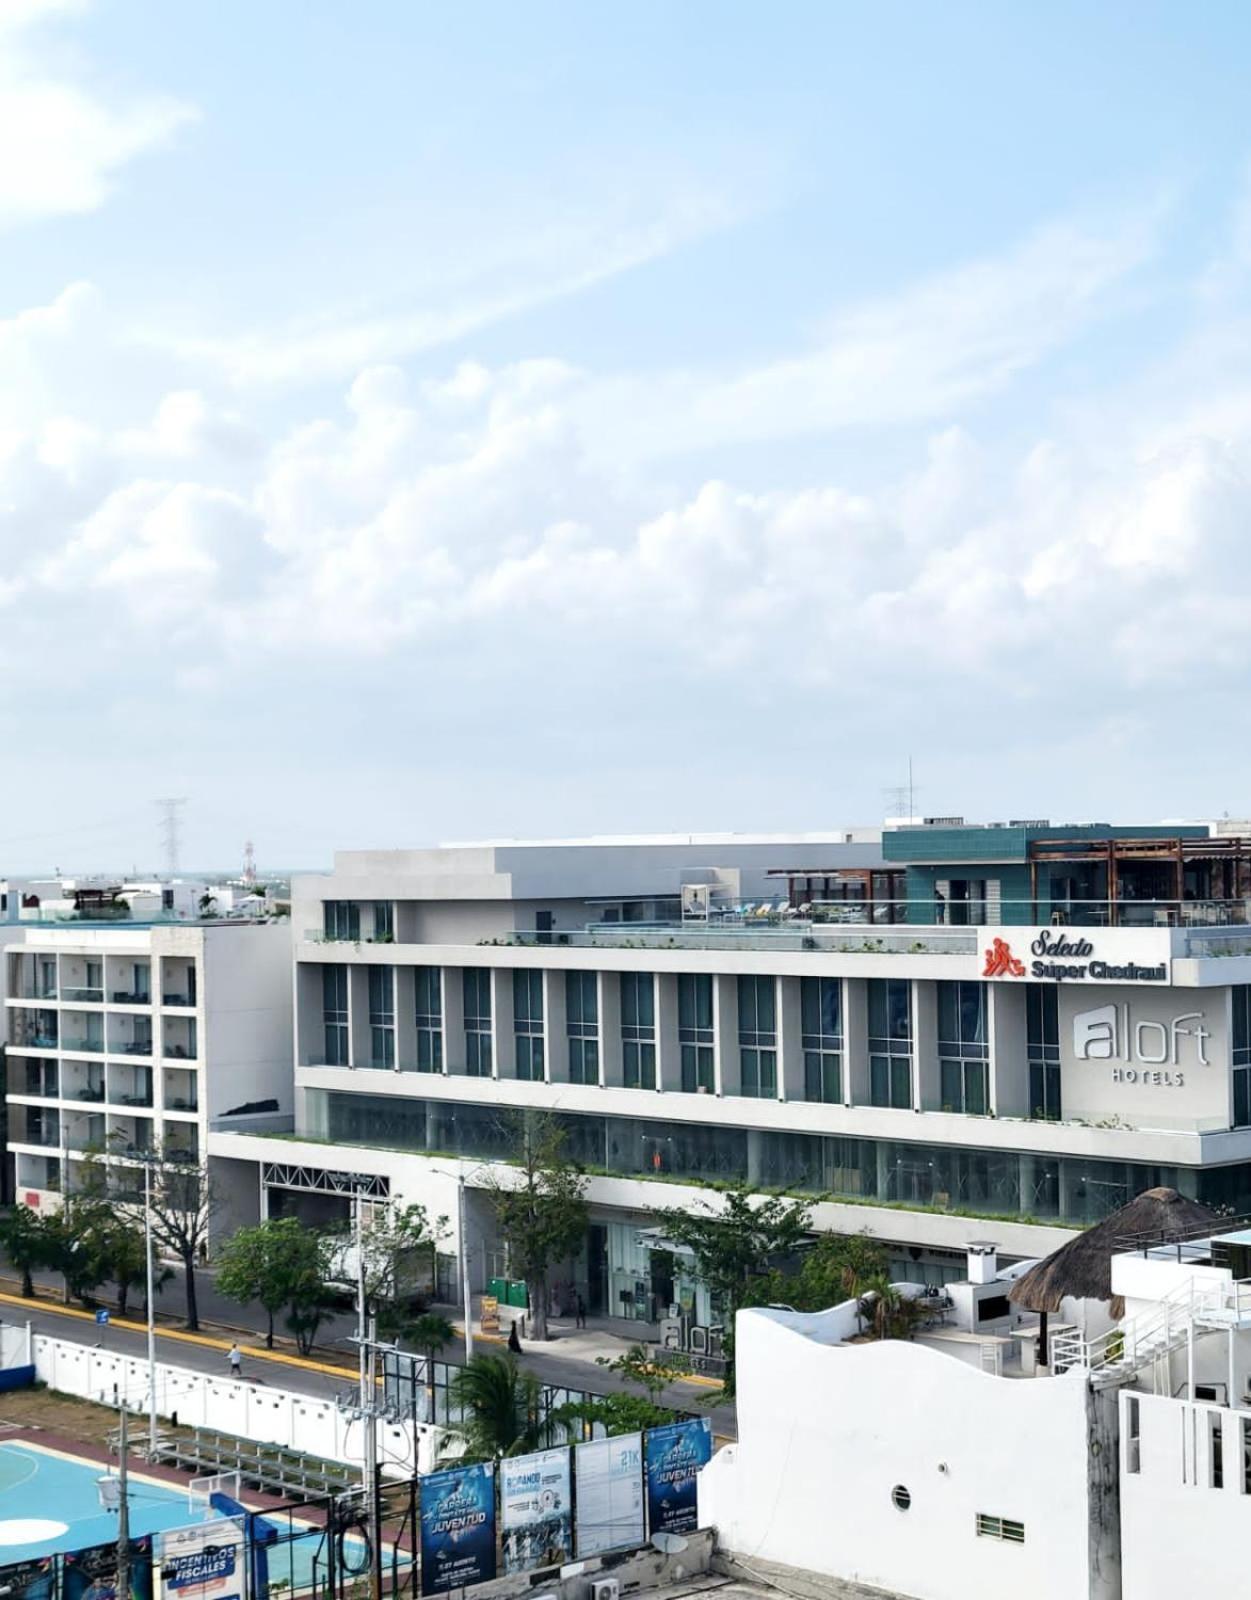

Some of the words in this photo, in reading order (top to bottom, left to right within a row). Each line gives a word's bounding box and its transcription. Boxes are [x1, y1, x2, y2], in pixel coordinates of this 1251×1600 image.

[1031, 930, 1093, 957] Selecto
[1089, 962, 1167, 981] Chedraui
[1073, 1002, 1211, 1066] aloft
[1111, 1068, 1185, 1087] HOTELS
[432, 1512, 486, 1534] JUVENTUD
[175, 1560, 226, 1581] FISCALES
